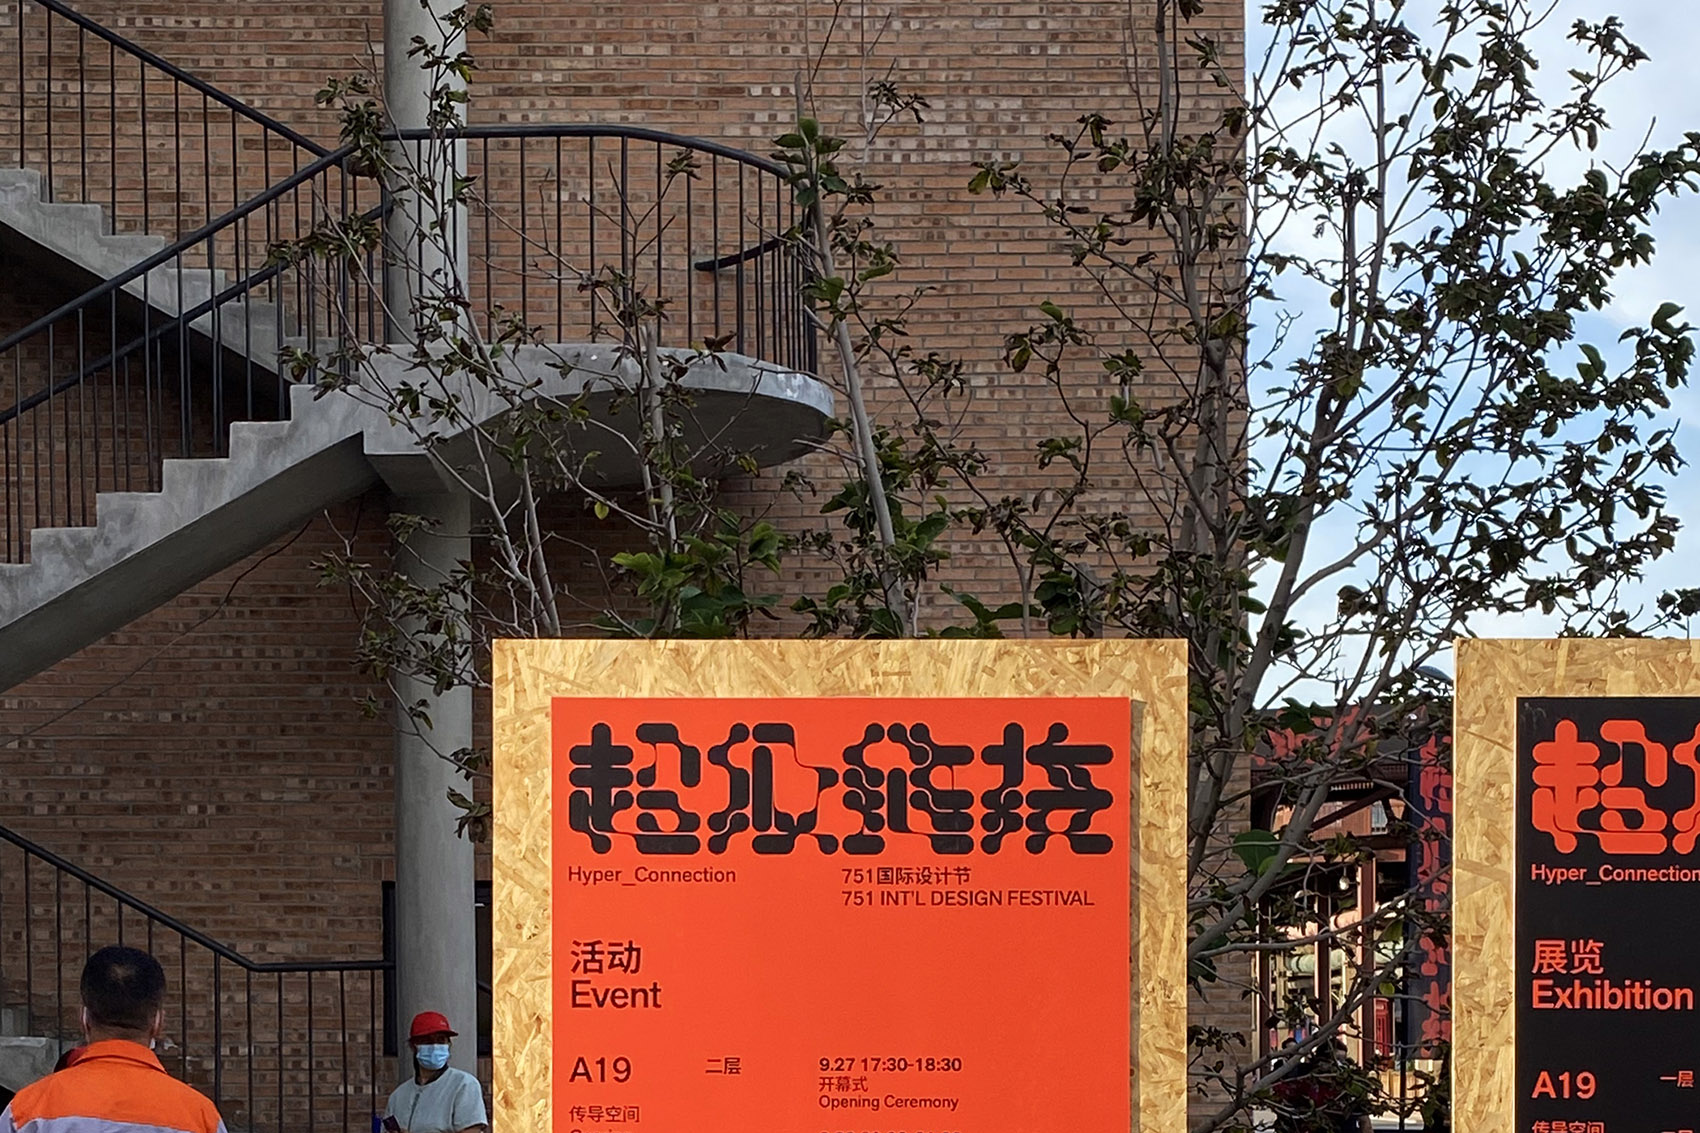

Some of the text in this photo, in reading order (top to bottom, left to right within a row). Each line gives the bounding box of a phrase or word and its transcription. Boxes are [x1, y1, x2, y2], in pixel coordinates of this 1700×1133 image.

[568, 866, 737, 887] Hyper_Connection
[841, 866, 971, 886] 751国际设计节
[1531, 864, 1700, 886] Hyper_Connection
[841, 890, 1095, 907] 751 INT'L DESIGN FESTIVAL
[570, 940, 642, 974] 活动
[1531, 939, 1604, 974] 展览
[571, 979, 663, 1009] Event
[1532, 979, 1694, 1010] Exhibition
[569, 1056, 632, 1083] A19
[705, 1057, 742, 1075] 二层
[818, 1057, 963, 1072] 9.27 17:30-18:30
[818, 1076, 869, 1093] 开幕式
[1531, 1071, 1597, 1099] A19
[1659, 1070, 1695, 1088] 一层
[818, 1095, 960, 1112] Opening Ceremony
[569, 1105, 640, 1123] 传导空间
